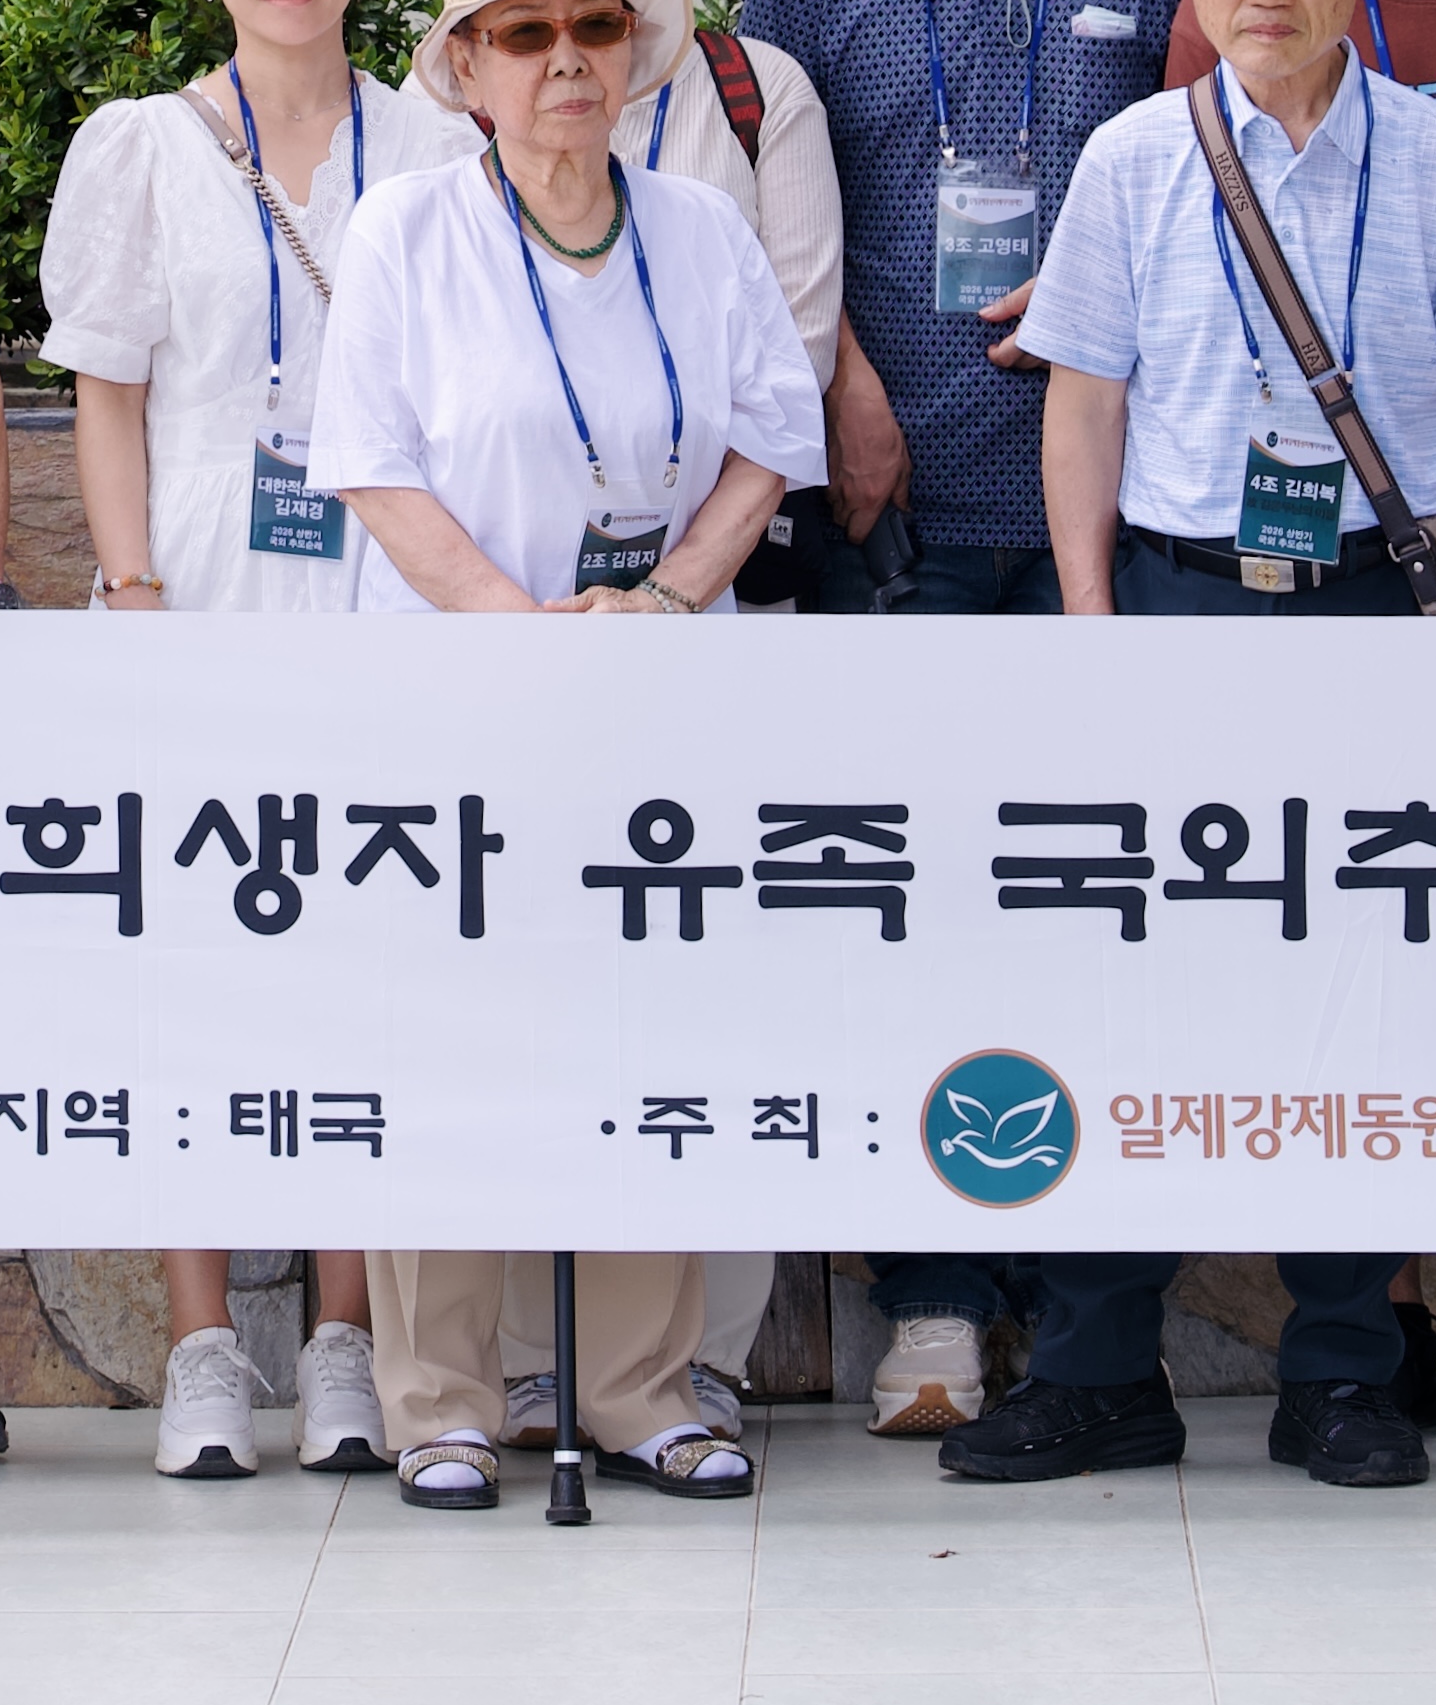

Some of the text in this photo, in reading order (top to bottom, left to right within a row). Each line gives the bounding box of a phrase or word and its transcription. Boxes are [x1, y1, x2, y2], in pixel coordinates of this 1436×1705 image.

[1216, 150, 1250, 213] HAZZYS
[944, 236, 1029, 256] 3조 고영태
[1249, 474, 1337, 504] 4조 김희복
[274, 497, 325, 520] 김재경
[272, 525, 322, 541] 2026 상반기
[1261, 524, 1313, 541] 2026 상반기
[581, 548, 657, 569] 2조 김경자
[581, 798, 915, 943] 유족
[229, 1089, 386, 1158] 태국
